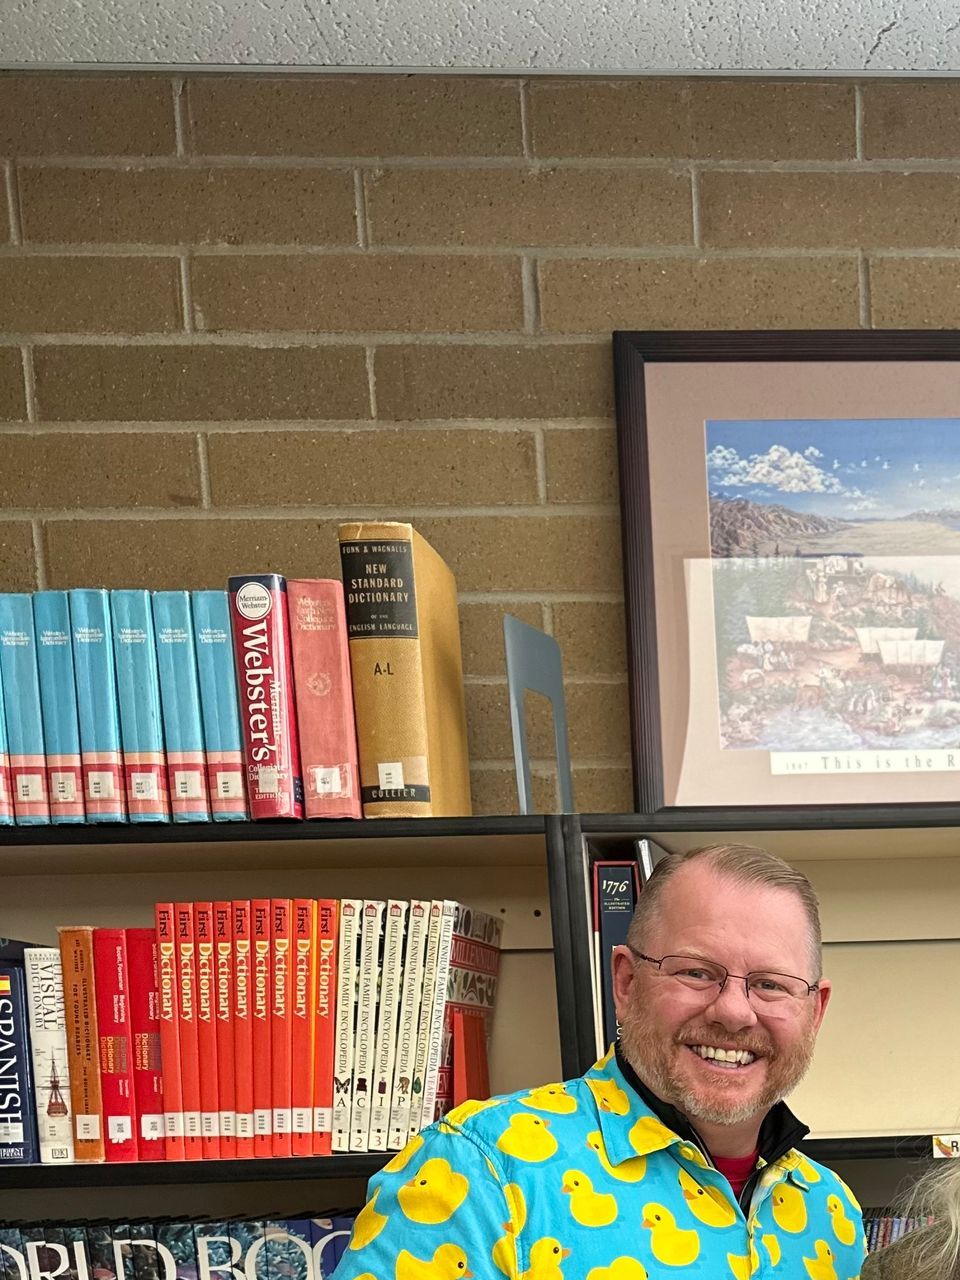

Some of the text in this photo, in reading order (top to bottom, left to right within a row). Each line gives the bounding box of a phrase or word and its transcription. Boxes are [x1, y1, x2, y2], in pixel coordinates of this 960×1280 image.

[342, 545, 408, 554] FUNK & WAGNALLS
[366, 564, 387, 574] NEW
[352, 578, 403, 589] STANDARD
[239, 594, 268, 604] Merriam-
[241, 602, 268, 610] Webster
[348, 592, 409, 604] DICTIONARY
[349, 622, 414, 632] ENGLISH LANGUAGE
[242, 619, 277, 762] Webster's
[821, 757, 862, 770] This
[876, 756, 892, 769] is
[905, 754, 933, 769] the
[602, 880, 629, 894] 1776
[159, 911, 175, 1023] First Dictionary
[179, 911, 194, 1023] First Dictionary
[217, 910, 231, 1023] First Dictionary
[236, 908, 249, 1021] First Dictionary
[317, 907, 334, 1020] First Dictionary
[30, 964, 46, 1030] DICTIONARY
[40, 964, 58, 1030] VISUAL
[82, 978, 90, 1021] ILLUSTRATED
[148, 991, 156, 1020] Dictionary
[339, 919, 352, 1074] MILLENNIUM FAMILY ENCYCLOPEDIA
[359, 920, 374, 1074] MILLENNIUM FAMILY ENCYCLOPEDIA
[380, 920, 398, 1074] MILLENNIUM FAMILY ENCYCLOPEDIA
[112, 994, 120, 1023] Dictionary
[118, 994, 126, 1023] Beginning
[107, 1036, 115, 1074] Dictionary
[141, 1033, 149, 1070] Dictionary
[336, 1097, 346, 1107] A
[357, 1097, 366, 1108] C
[379, 1097, 383, 1107] I
[397, 1097, 405, 1107] P
[338, 1137, 342, 1147] 1
[355, 1137, 363, 1148] 2
[375, 1136, 382, 1146] 3
[392, 1135, 400, 1146] 4
